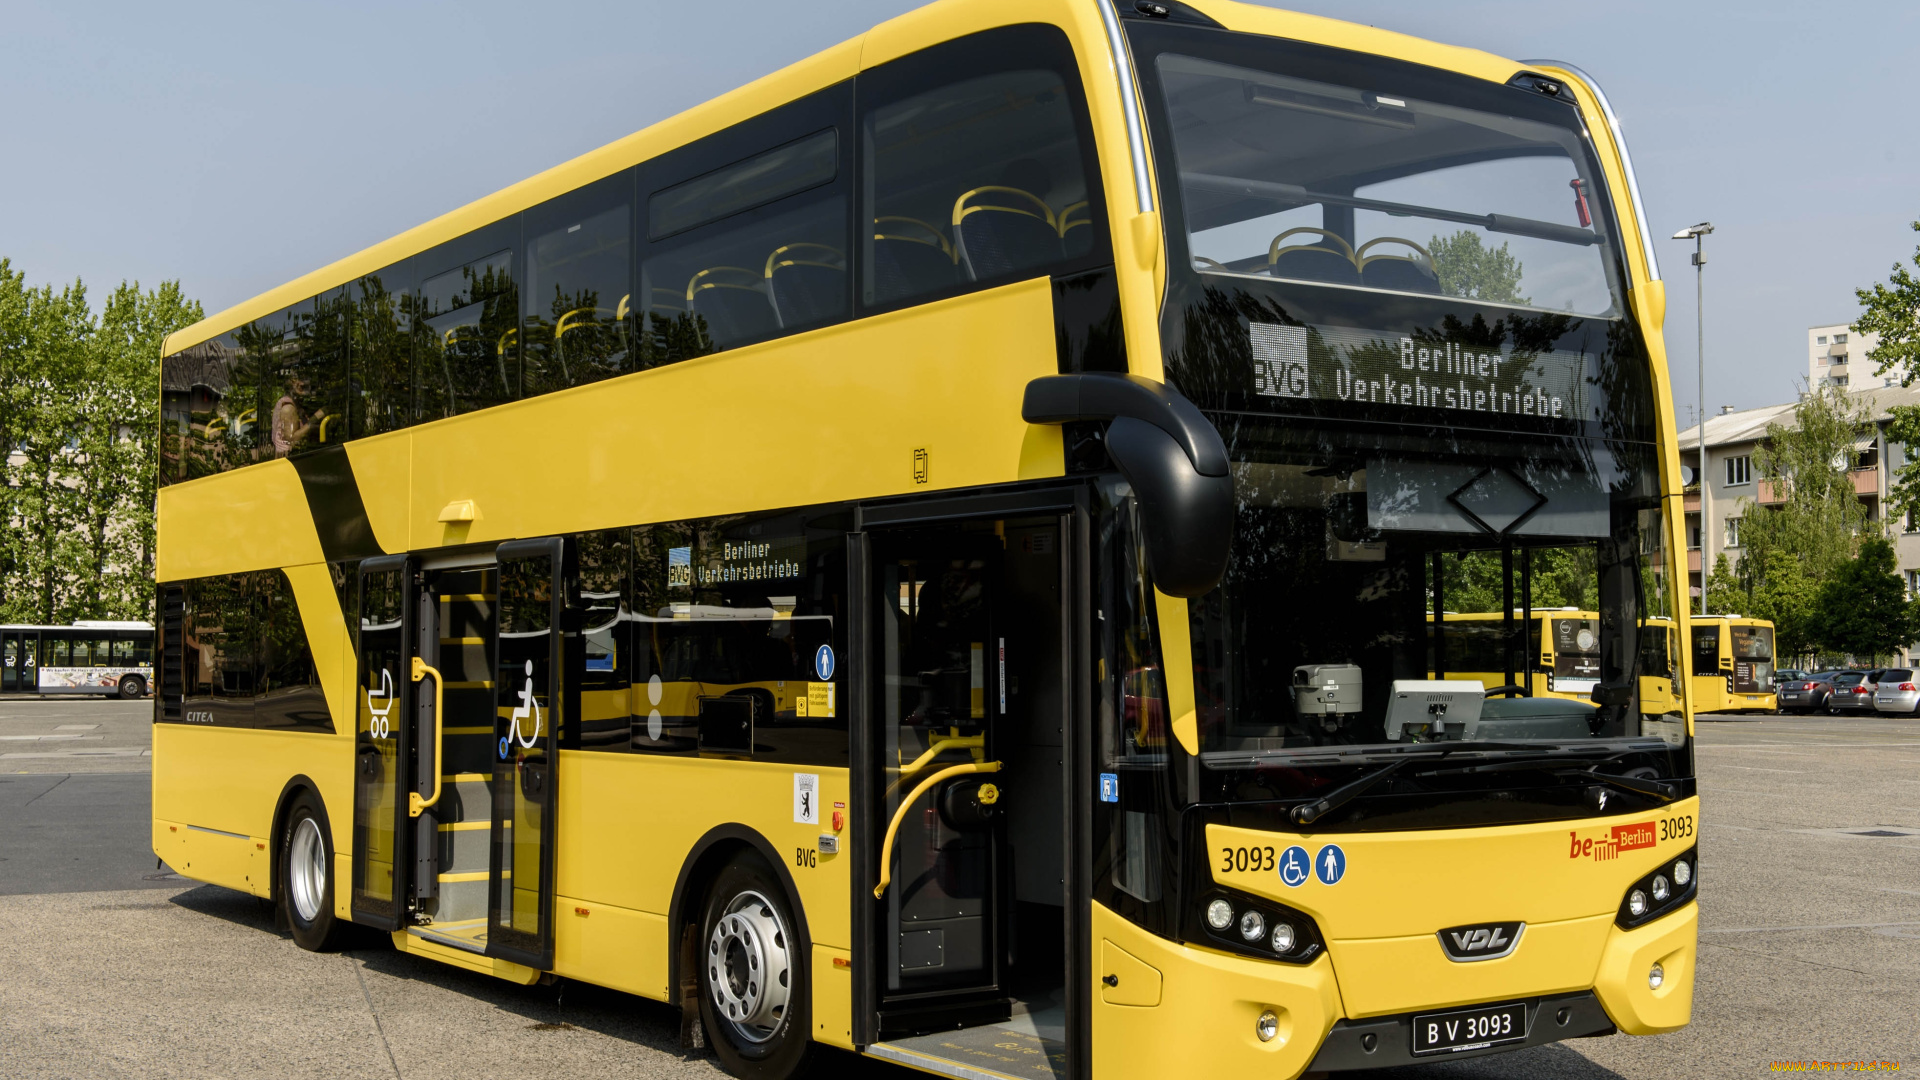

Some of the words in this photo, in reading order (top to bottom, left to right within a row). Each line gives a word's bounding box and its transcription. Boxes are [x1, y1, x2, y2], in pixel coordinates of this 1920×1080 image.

[1400, 337, 1503, 378] Berliner
[1254, 359, 1306, 397] BVG
[1335, 369, 1563, 419] Verkehrsbetriebe
[725, 541, 770, 561] Berliner
[669, 564, 690, 584] BVG
[698, 559, 799, 584] Verkehrsbetriebe
[186, 711, 214, 723] CITEA
[1619, 828, 1653, 847] Berlin
[1660, 815, 1693, 842] 3093
[796, 848, 816, 868] BVG
[1569, 832, 1592, 859] be
[1221, 847, 1275, 873] 3093
[1450, 927, 1508, 951] VDL
[1428, 1023, 1439, 1044] B
[1446, 1020, 1459, 1041] V
[1466, 1014, 1511, 1039] 3093
